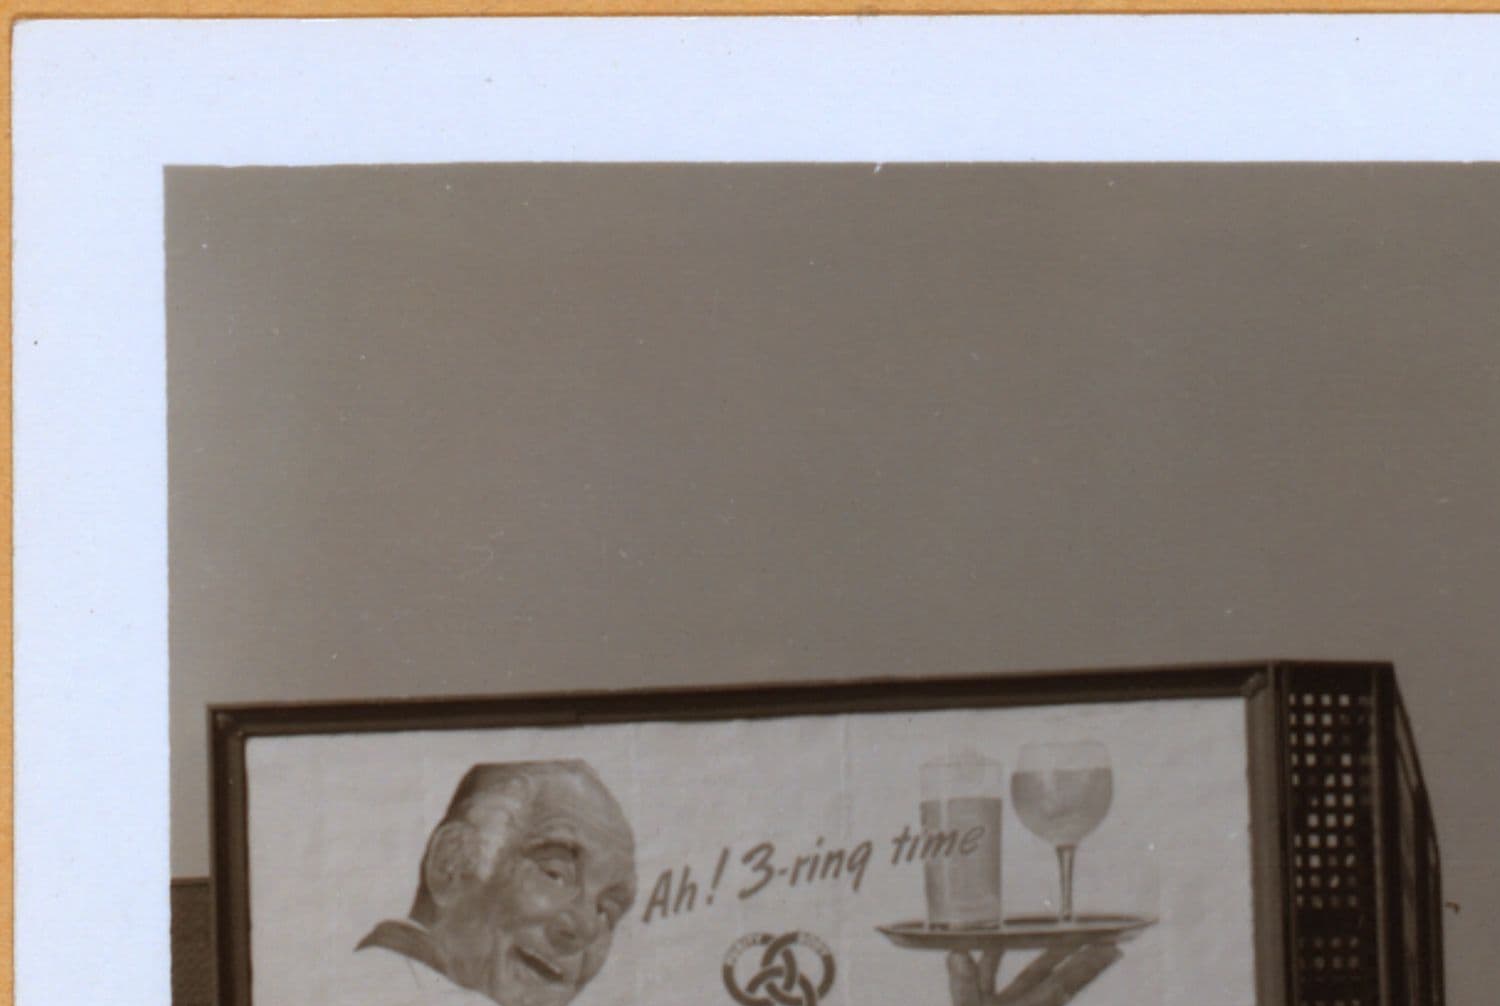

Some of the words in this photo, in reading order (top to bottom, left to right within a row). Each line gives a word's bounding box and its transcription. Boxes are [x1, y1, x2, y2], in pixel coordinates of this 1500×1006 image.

[641, 847, 731, 923] Ah!
[738, 836, 873, 899] 3-ring
[891, 825, 986, 866] time
